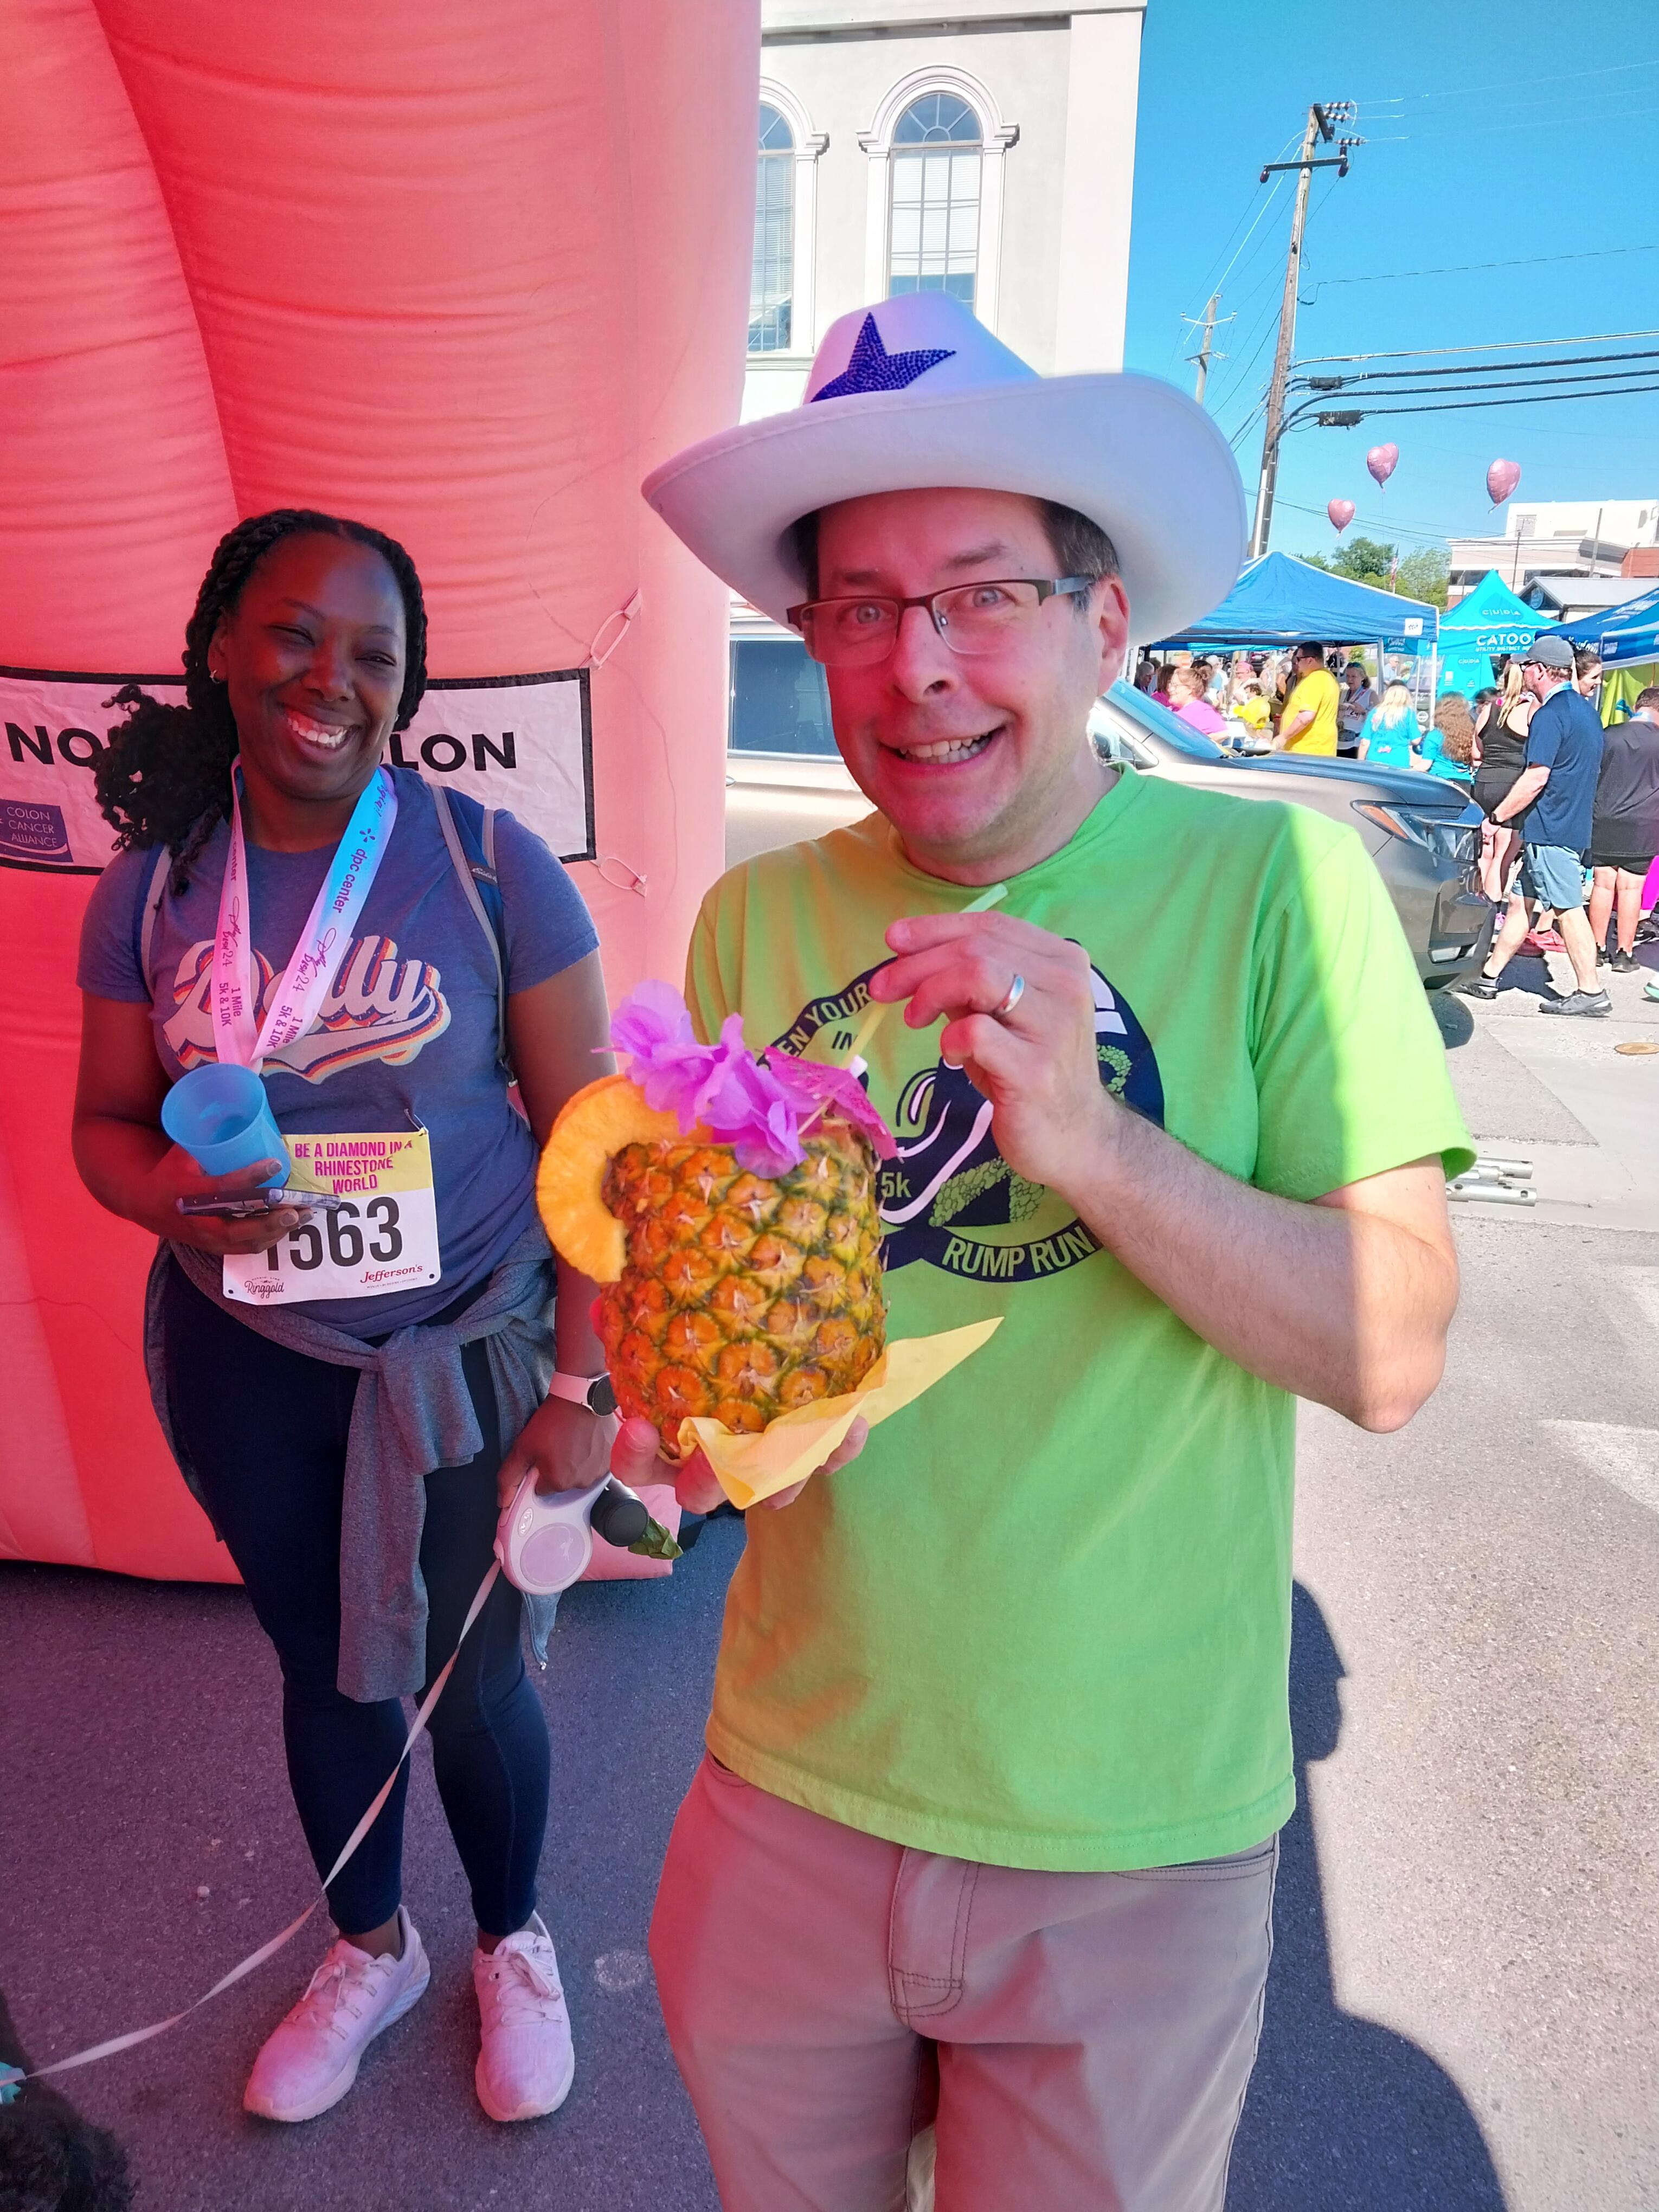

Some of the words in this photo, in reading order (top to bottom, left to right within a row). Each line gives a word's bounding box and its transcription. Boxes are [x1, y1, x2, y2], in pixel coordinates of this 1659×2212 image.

[1476, 632, 1535, 646] CATOO
[4, 722, 110, 767] NO
[380, 731, 516, 772] LON
[7, 807, 50, 820] COLON
[8, 820, 54, 833] CANCER
[11, 833, 57, 847] ALLIANCE
[350, 848, 368, 872] dpc
[333, 874, 356, 913] center
[222, 950, 234, 967] 24
[292, 977, 310, 992] 24
[163, 935, 450, 1076] Dlly
[232, 996, 243, 1017] Mile
[220, 1007, 232, 1026] 10K
[776, 1026, 812, 1057] EN
[805, 982, 872, 1027] YOUR
[267, 1029, 283, 1048] 10K
[282, 1025, 300, 1044] Mile
[294, 1143, 311, 1158] BE
[314, 1142, 323, 1158] A
[326, 1141, 385, 1157] DIAMOND
[390, 1141, 402, 1154] IN
[404, 1140, 413, 1149] A
[314, 1156, 394, 1176] RHINESTONE
[332, 1174, 378, 1194] WORLD
[881, 1172, 912, 1198] 5k
[942, 1237, 1025, 1277] RUMP
[1030, 1225, 1096, 1274] RUN
[360, 1264, 423, 1283] Jefferson's
[244, 1281, 285, 1299] Ringgold
